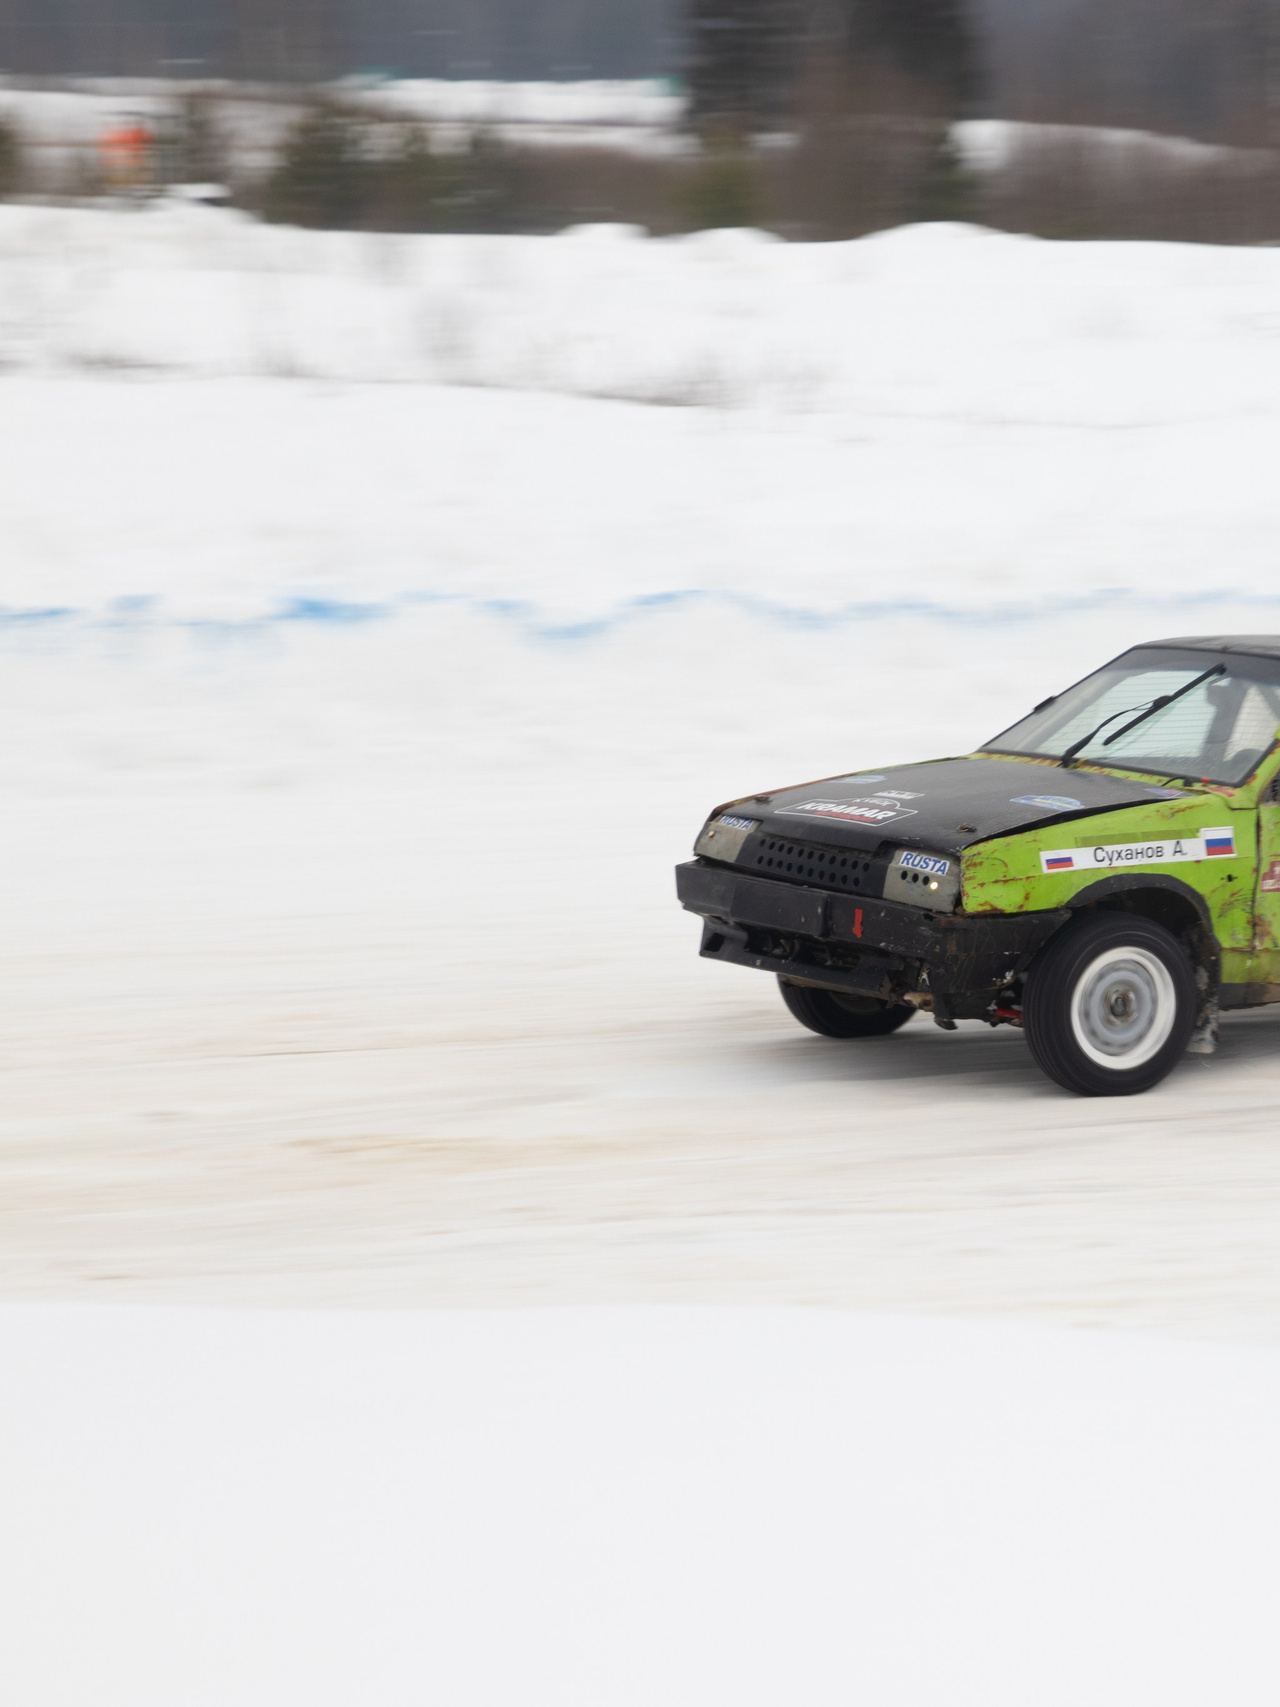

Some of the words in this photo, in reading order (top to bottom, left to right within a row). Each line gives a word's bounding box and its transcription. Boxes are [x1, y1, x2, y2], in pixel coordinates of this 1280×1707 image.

[796, 802, 897, 820] KRAMAR
[720, 814, 754, 830] RUSTA
[901, 852, 948, 875] RUSTA
[1093, 845, 1164, 866] Суханов
